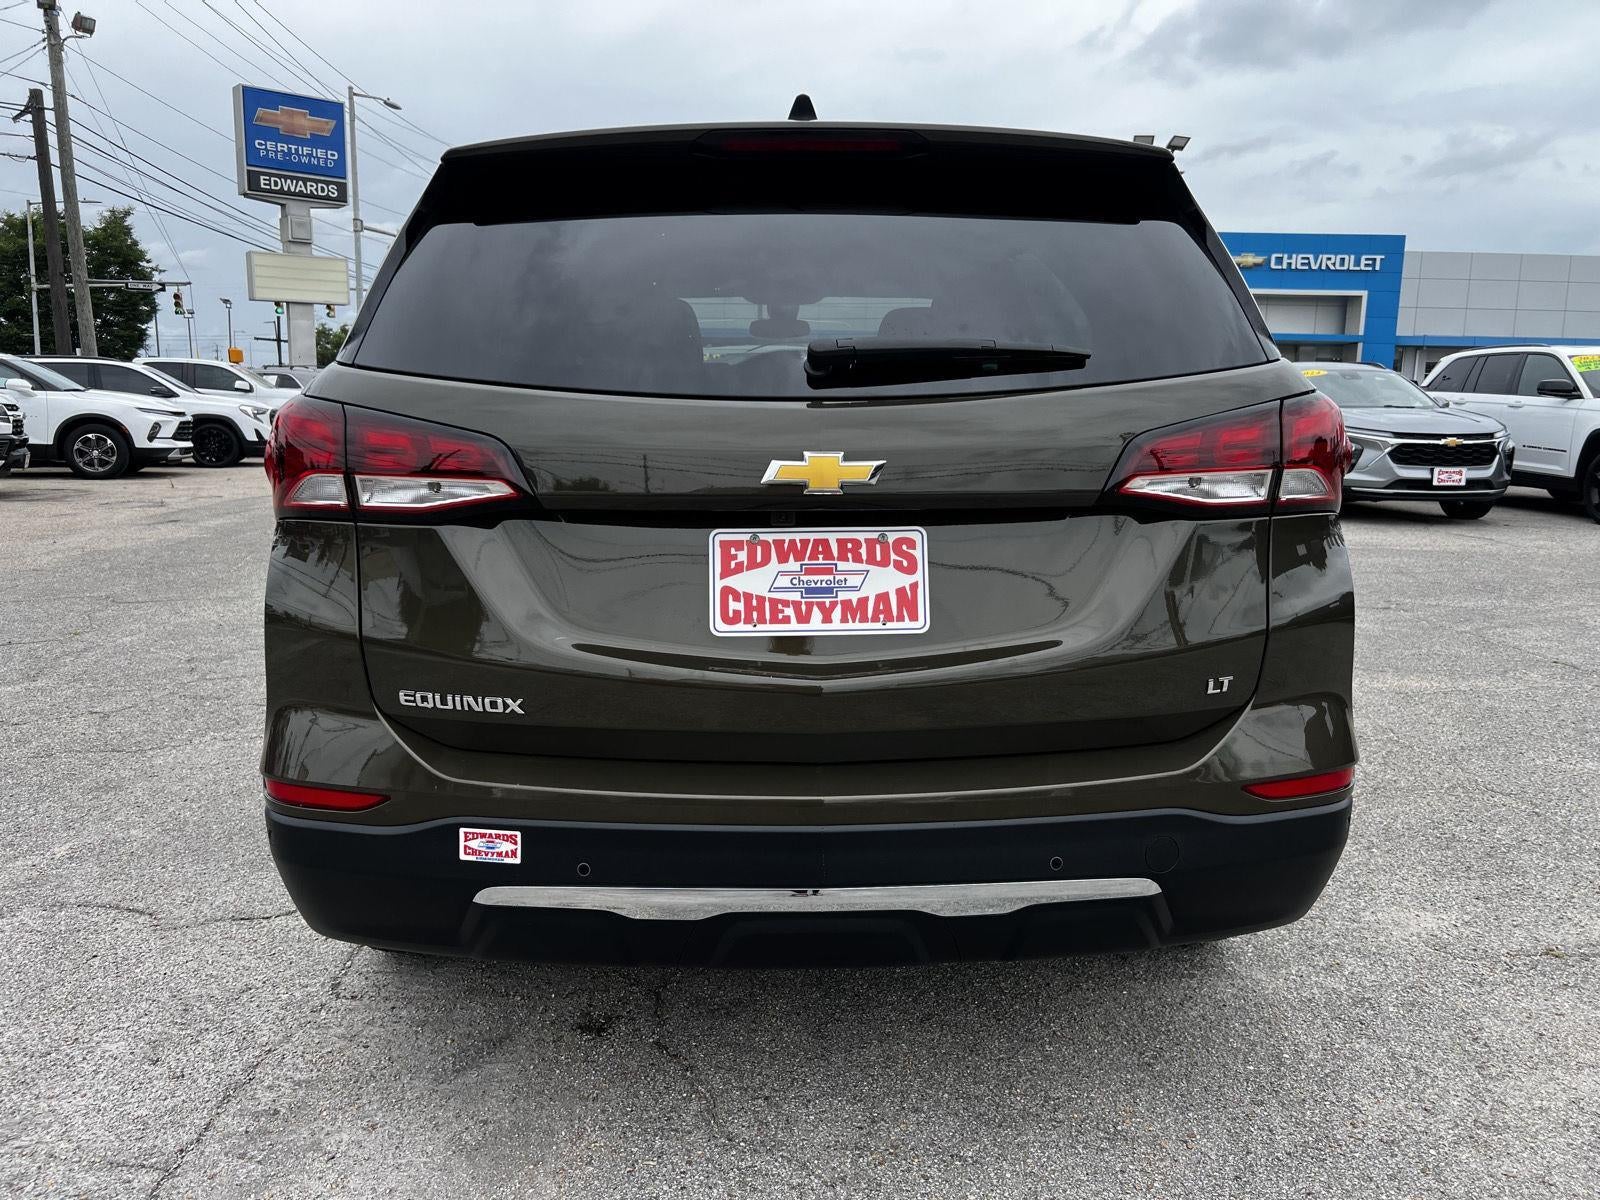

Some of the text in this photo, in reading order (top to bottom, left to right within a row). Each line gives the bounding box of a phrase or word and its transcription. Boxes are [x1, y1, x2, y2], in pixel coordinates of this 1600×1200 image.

[254, 139, 339, 161] CERTIFIED
[259, 150, 334, 168] PRE-OWNED
[259, 175, 339, 198] EDWARDS
[1270, 253, 1385, 271] CHEVROLET
[719, 536, 918, 580] EDWARDS
[789, 576, 849, 587] Chevrolet
[719, 580, 919, 625] CHEVYMAN
[1207, 675, 1234, 694] LT
[398, 689, 526, 715] EQUINOX
[463, 831, 518, 847] EDWARDS
[463, 843, 518, 859] CHEVYMAN
